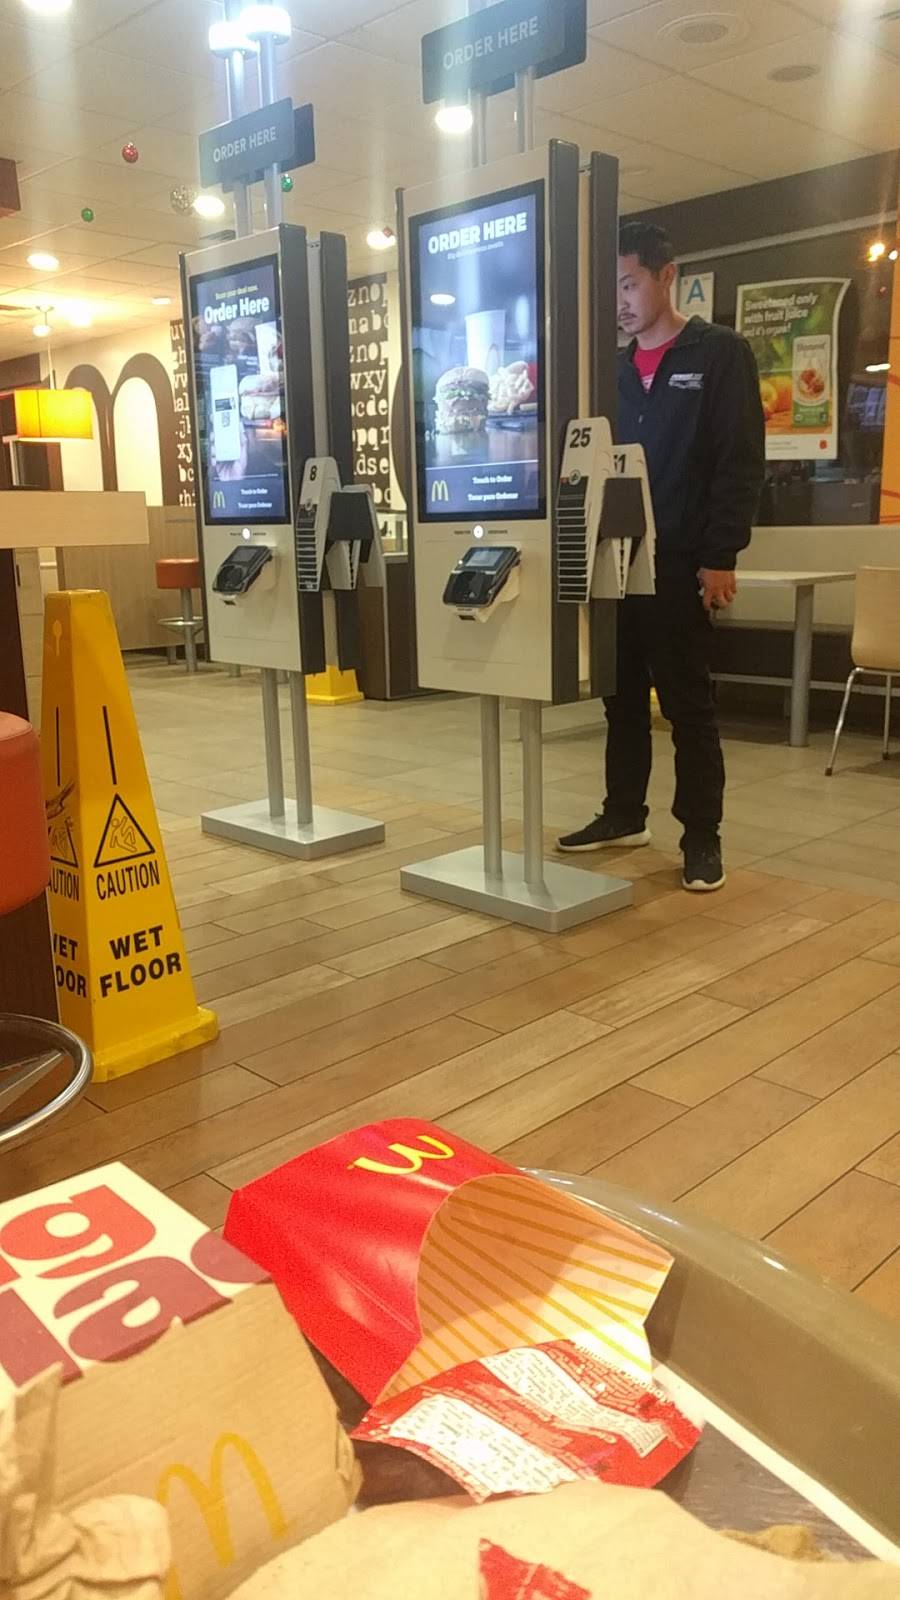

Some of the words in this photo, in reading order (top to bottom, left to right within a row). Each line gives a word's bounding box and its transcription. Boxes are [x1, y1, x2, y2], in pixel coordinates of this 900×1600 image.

[443, 35, 493, 70] ORDER
[498, 15, 538, 49] HERE
[213, 137, 247, 162] ORDER
[249, 126, 277, 149] HERE
[428, 224, 481, 254] ORDER
[483, 211, 527, 241] HERE
[687, 278, 705, 304] A
[796, 292, 820, 305] only
[204, 302, 238, 324] Order
[239, 296, 269, 317] Here
[744, 312, 764, 324] with
[764, 310, 785, 322] fruit
[784, 307, 809, 322] juice
[569, 427, 592, 448] 25
[310, 465, 318, 481] 8
[95, 860, 160, 901] CAUTION
[109, 924, 163, 960] WET
[56, 965, 87, 998] OOR
[99, 952, 182, 998] FLOOR
